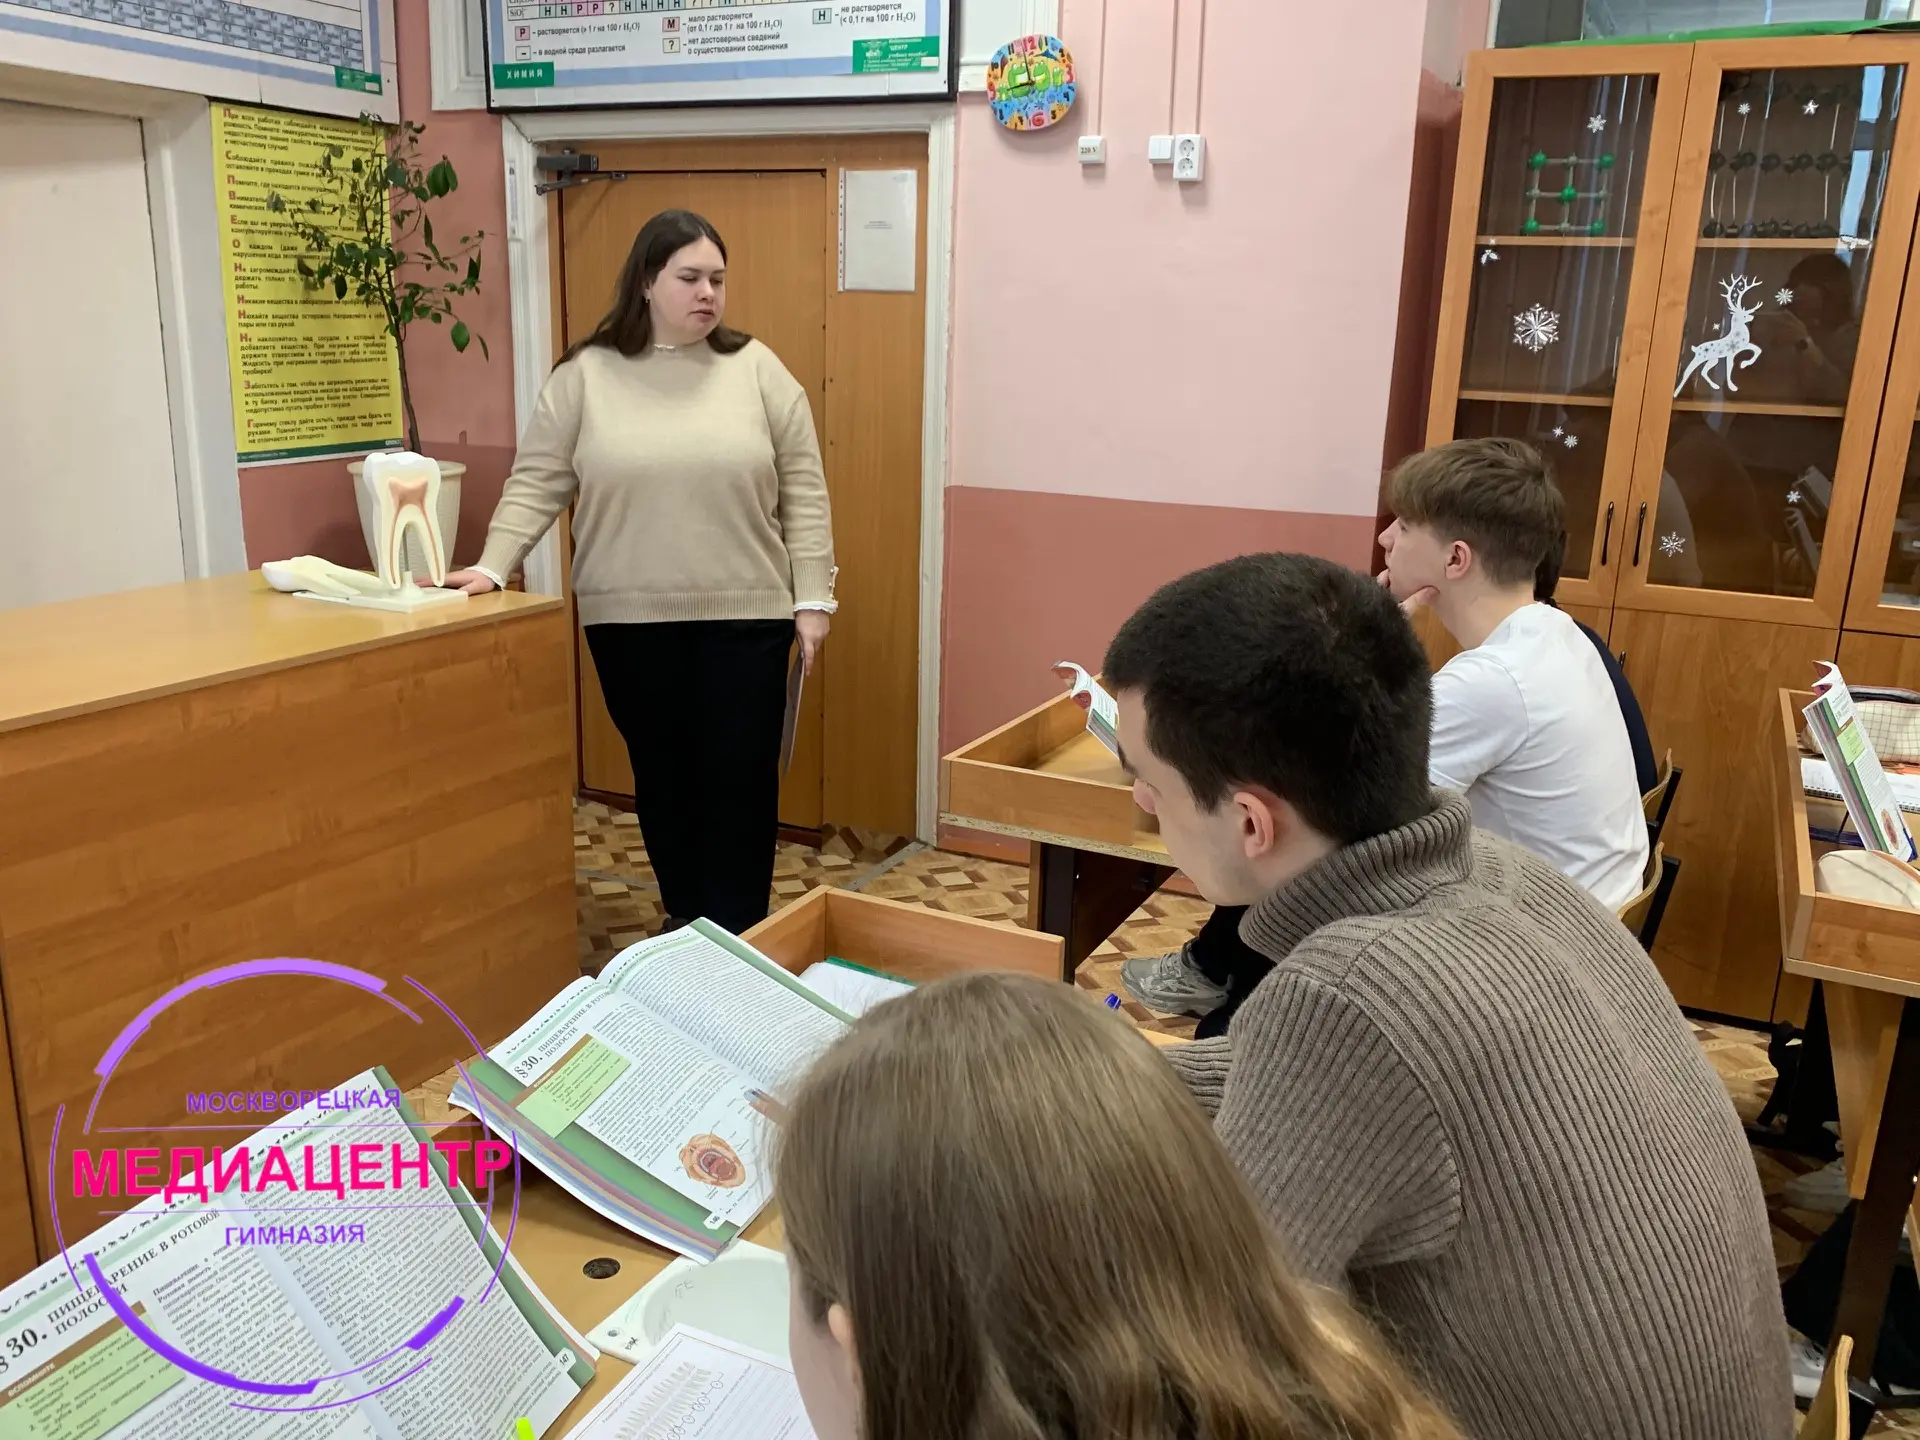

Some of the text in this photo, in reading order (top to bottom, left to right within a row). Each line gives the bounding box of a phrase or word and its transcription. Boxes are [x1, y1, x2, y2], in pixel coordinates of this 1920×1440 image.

[851, 3, 902, 14] растворяется
[707, 12, 753, 22] растворяется
[818, 10, 826, 20] Н
[848, 14, 859, 26] 0,1
[876, 14, 889, 22] 100
[606, 23, 617, 32] 100
[667, 20, 676, 29] М
[687, 24, 696, 34] (от
[698, 22, 708, 32] 0,1
[714, 24, 722, 32] до
[746, 20, 758, 28] 100
[700, 35, 746, 44] достоверных
[748, 32, 780, 42] сведений
[1022, 36, 1036, 52] 12
[544, 47, 566, 56] водной
[588, 44, 626, 54] разлагается
[694, 46, 746, 56] существовании
[747, 42, 788, 52] соединения
[507, 69, 542, 79] ХИМИЯ
[1066, 64, 1074, 84] 3
[1032, 112, 1045, 127] 6
[538, 1007, 588, 1052] ПИЩЕВАРЕНИЕ
[545, 1027, 578, 1058] ПОЛОСТИ
[159, 1241, 170, 1252] В
[170, 1208, 220, 1246] РОТОВОЙ
[560, 1354, 570, 1366] 147
